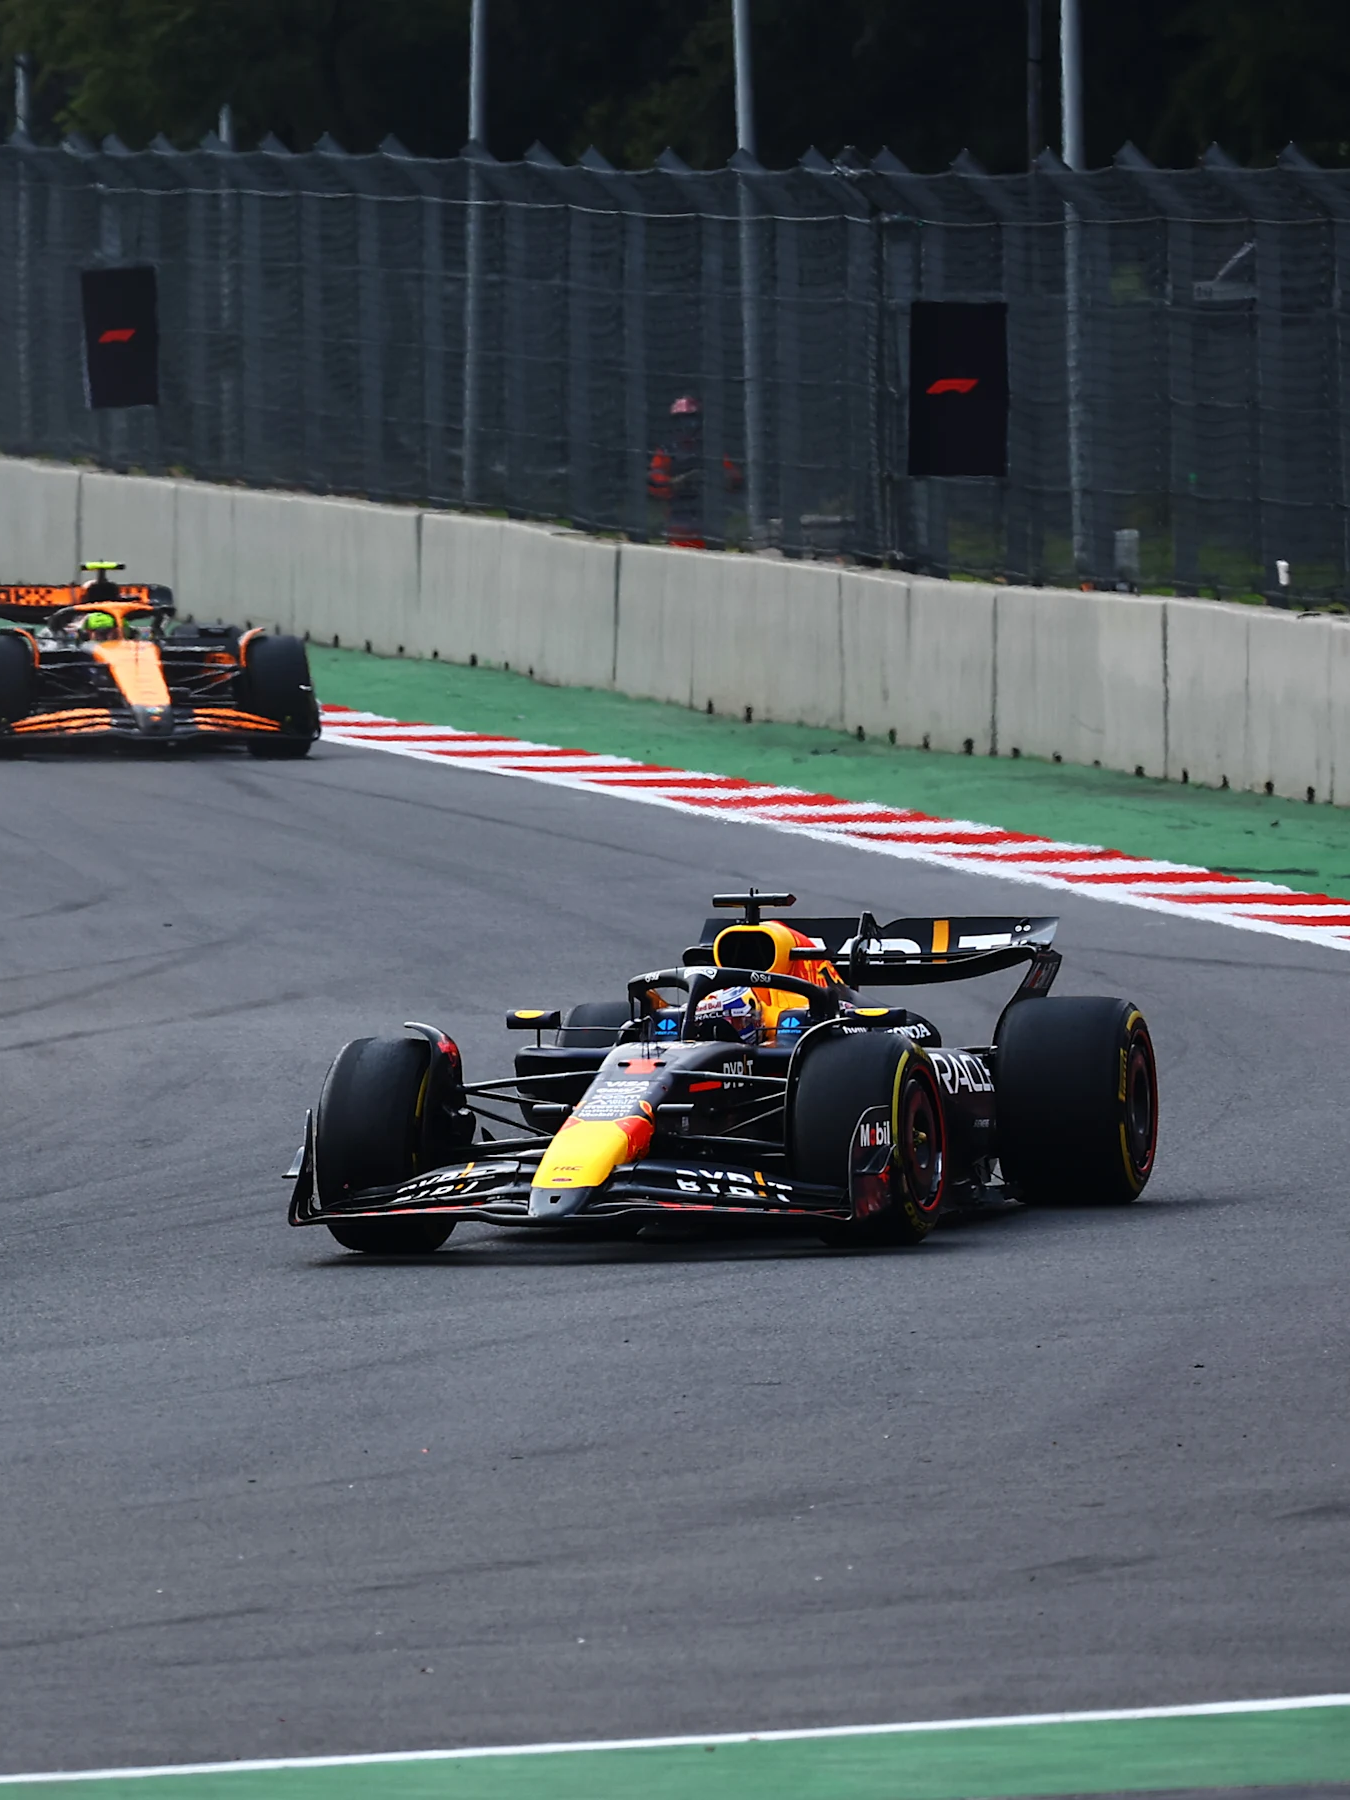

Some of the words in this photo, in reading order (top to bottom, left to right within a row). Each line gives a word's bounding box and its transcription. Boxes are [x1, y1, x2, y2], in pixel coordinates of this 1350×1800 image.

[708, 1001, 722, 1010] Bull
[695, 1010, 730, 1021] RACLE
[883, 1022, 932, 1039] ONDA
[928, 1053, 996, 1094] RACLE
[860, 1120, 891, 1147] Mobil
